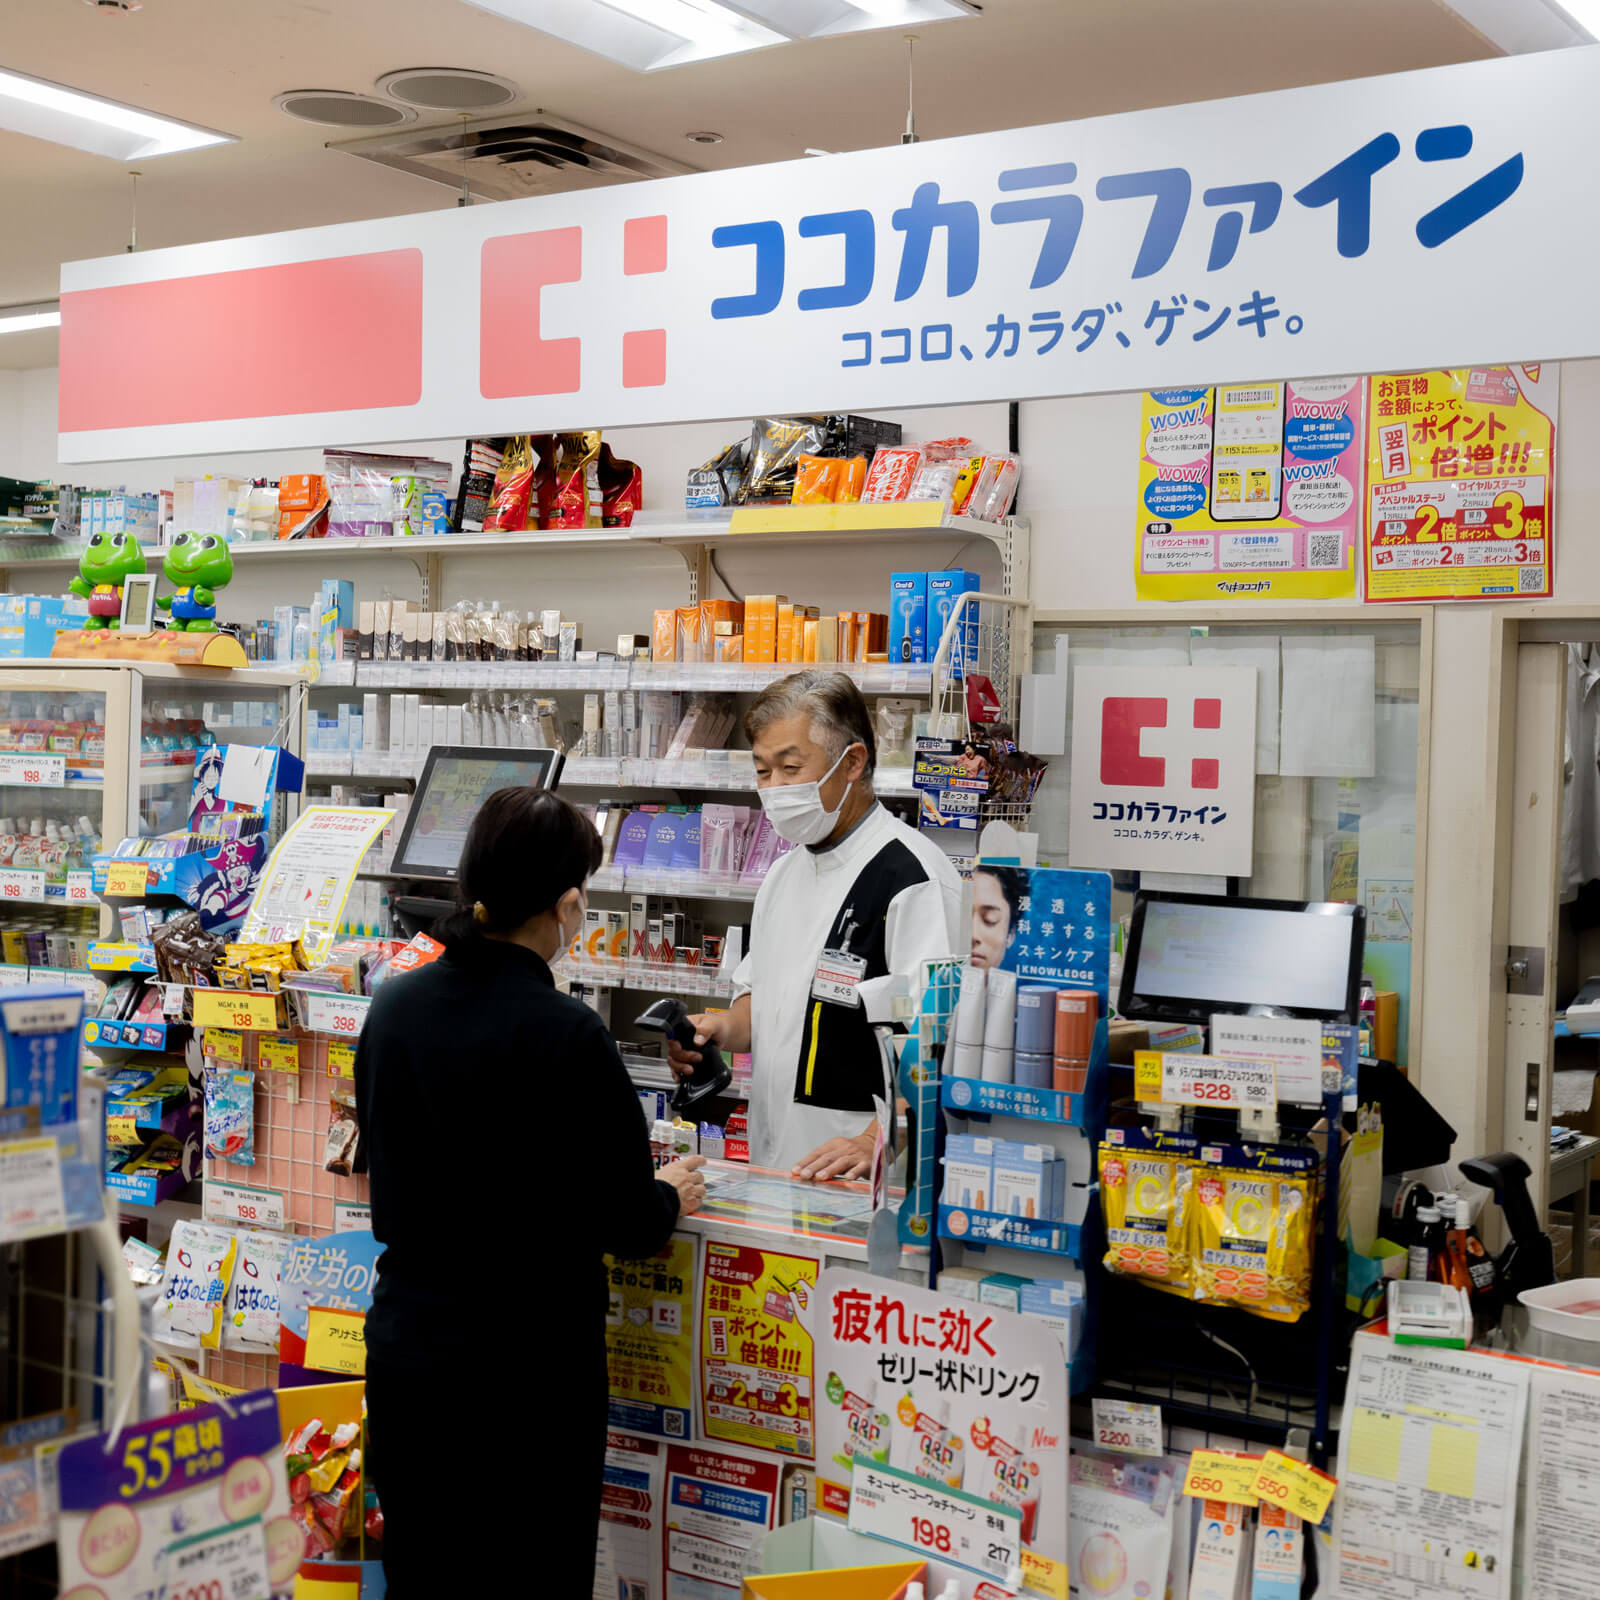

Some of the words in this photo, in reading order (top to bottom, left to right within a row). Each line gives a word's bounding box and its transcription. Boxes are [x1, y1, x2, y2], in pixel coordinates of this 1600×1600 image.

[711, 124, 1524, 320] ココカラファイン
[840, 289, 1304, 367] ココロ、カラダ、ゲンキ。
[1378, 377, 1429, 398] お買物
[1150, 401, 1207, 432] WOW!
[1294, 400, 1348, 420] WOW!
[1377, 398, 1463, 417] 金額によって、
[1412, 411, 1507, 444] ポイント
[1384, 429, 1405, 473] 翌月
[1158, 465, 1208, 483] WOW!
[1284, 456, 1339, 482] WOW!
[1458, 479, 1527, 492] ロイヤルステージ
[1379, 493, 1446, 505] スペシャルステージ
[1380, 535, 1412, 546] ポイント
[1459, 528, 1492, 540] ポイント
[24, 770, 40, 783] 198
[1092, 801, 1227, 825] ココカラファイン
[1113, 828, 1205, 842] ココロ、カラダ、ゲンキ。
[4, 884, 20, 897] 198
[71, 887, 86, 899] 128
[110, 880, 126, 891] 210
[1017, 895, 1097, 917] 浸透を
[1016, 919, 1096, 940] 科学する
[1017, 944, 1095, 963] スキンケア
[1021, 964, 1095, 981] KNOWLEDGE
[232, 1013, 253, 1027] 138
[332, 1016, 356, 1031] 398
[1193, 1082, 1232, 1101] 528
[237, 1204, 258, 1220] 198
[284, 1242, 382, 1296] 疲労の
[234, 1284, 281, 1312] はなのど
[728, 1315, 787, 1345] ポイント
[832, 1287, 997, 1358] 疲れに効く
[877, 1352, 1040, 1403] ゼリー状ドリンク
[1030, 1426, 1060, 1451] New
[1190, 1475, 1224, 1493] 650
[1256, 1475, 1289, 1500] 550
[911, 1515, 952, 1553] 198
